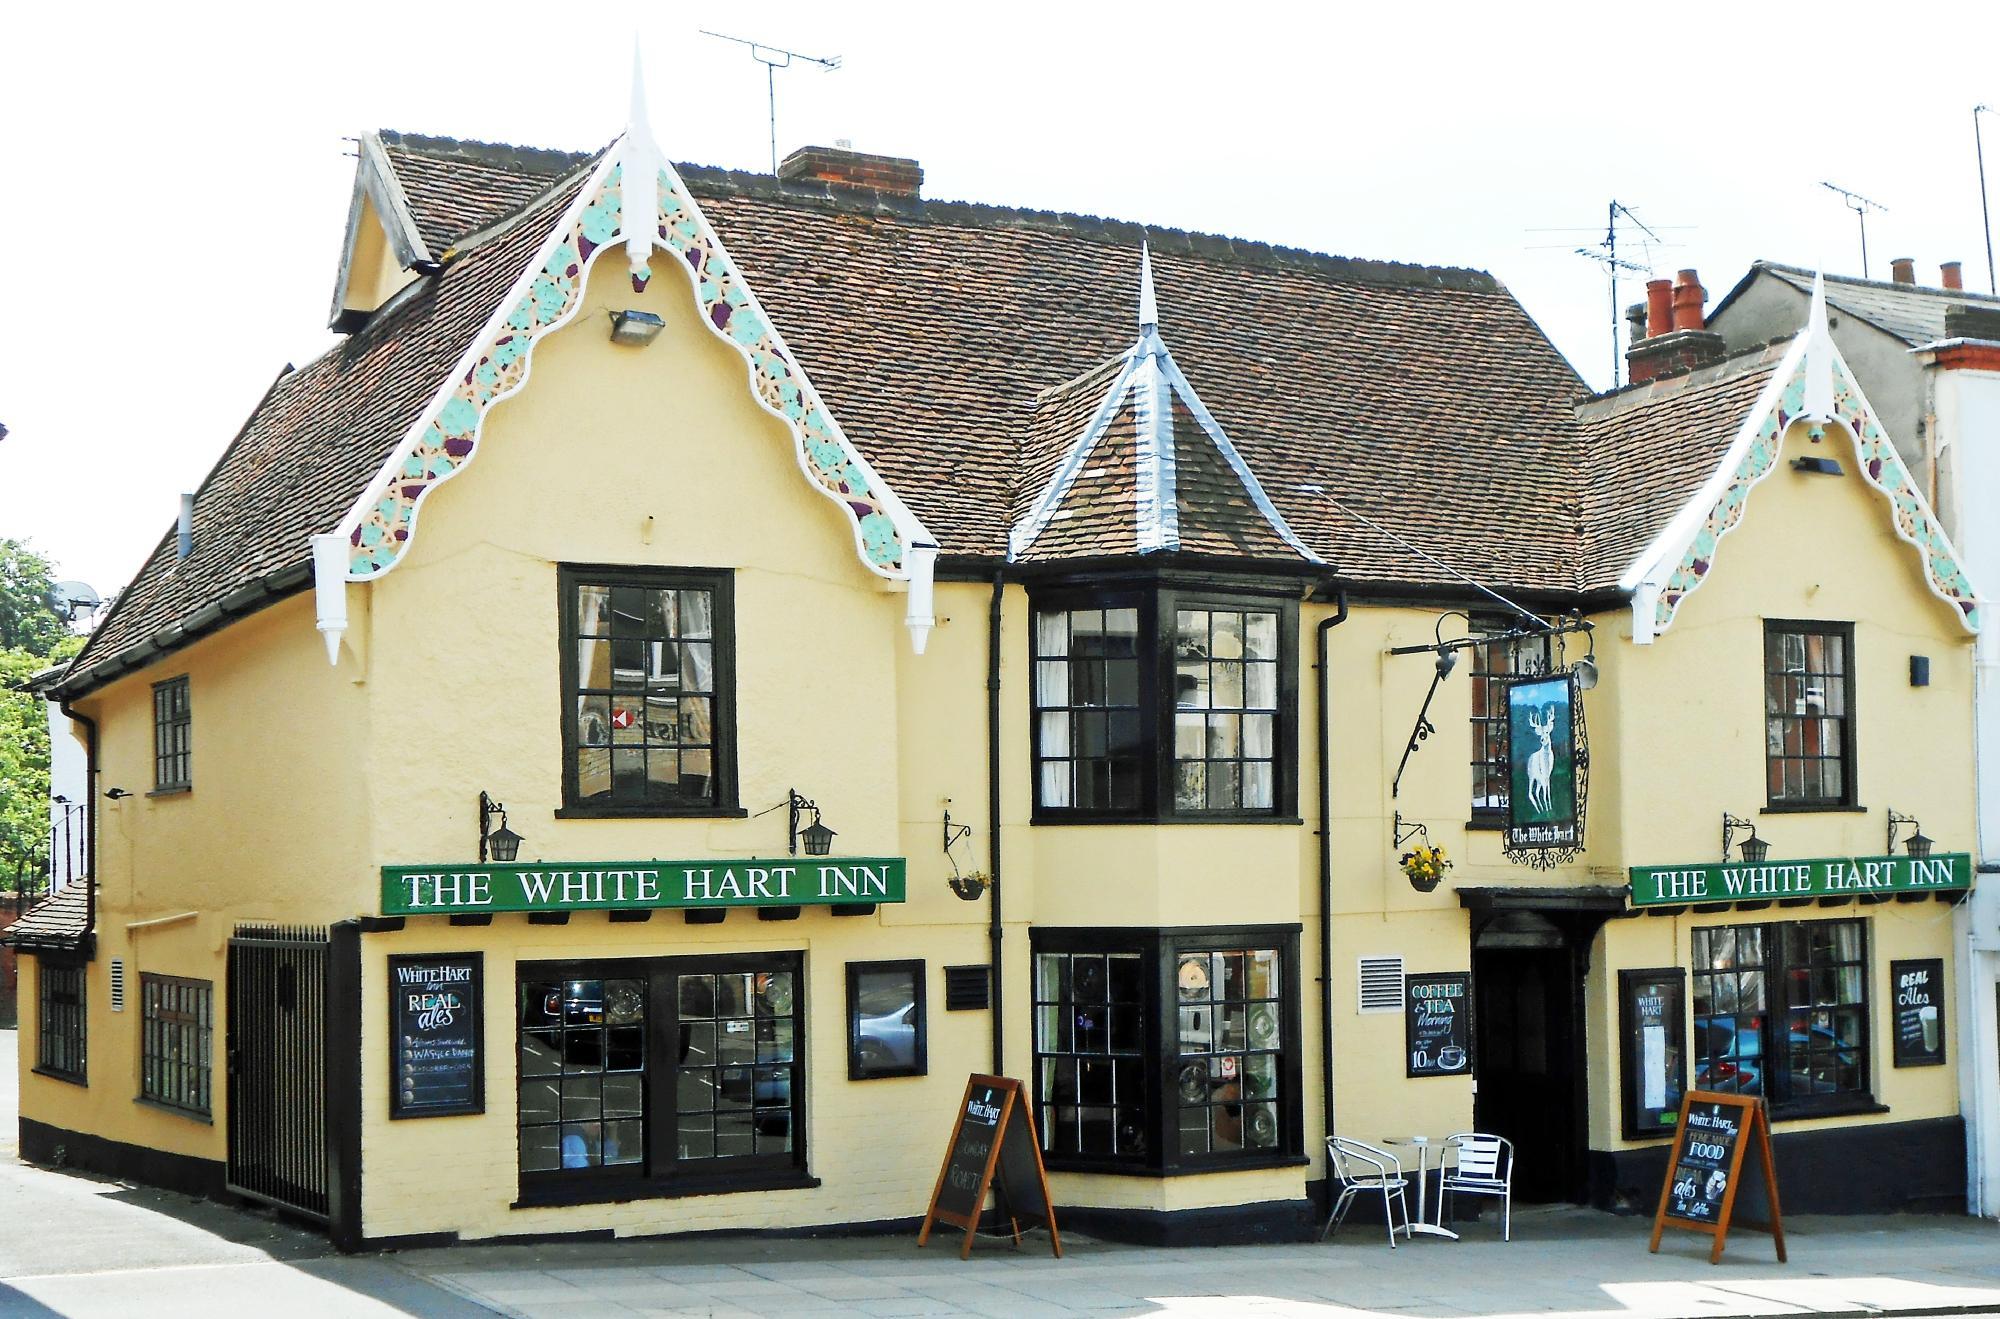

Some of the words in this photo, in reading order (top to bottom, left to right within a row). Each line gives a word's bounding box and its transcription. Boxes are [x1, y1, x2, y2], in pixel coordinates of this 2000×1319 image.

[1512, 828, 1528, 843] The
[1529, 826, 1552, 842] White
[1553, 824, 1575, 841] Hart
[402, 873, 494, 908] THE
[516, 869, 661, 904] WHITE
[682, 866, 797, 901] HART
[817, 864, 890, 898] INN
[1651, 869, 1708, 899] THE
[1722, 864, 1812, 896] WHITE
[1824, 861, 1897, 891] HART
[1909, 858, 1955, 886] INN
[440, 965, 473, 982] HART
[1900, 970, 1929, 988] REAL
[1412, 983, 1464, 999] COFFEE
[1898, 986, 1930, 1006] Ales
[408, 993, 461, 1012] REAL
[1414, 1002, 1425, 1013] &
[1424, 998, 1456, 1014] TEA
[1638, 997, 1665, 1007] WHITE
[417, 1002, 454, 1030] ales
[1641, 1006, 1663, 1017] HART
[1417, 1013, 1454, 1034] Morning
[1412, 1050, 1428, 1068] 10
[1689, 1142, 1725, 1160] FOOD
[1673, 1177, 1698, 1200] ales
